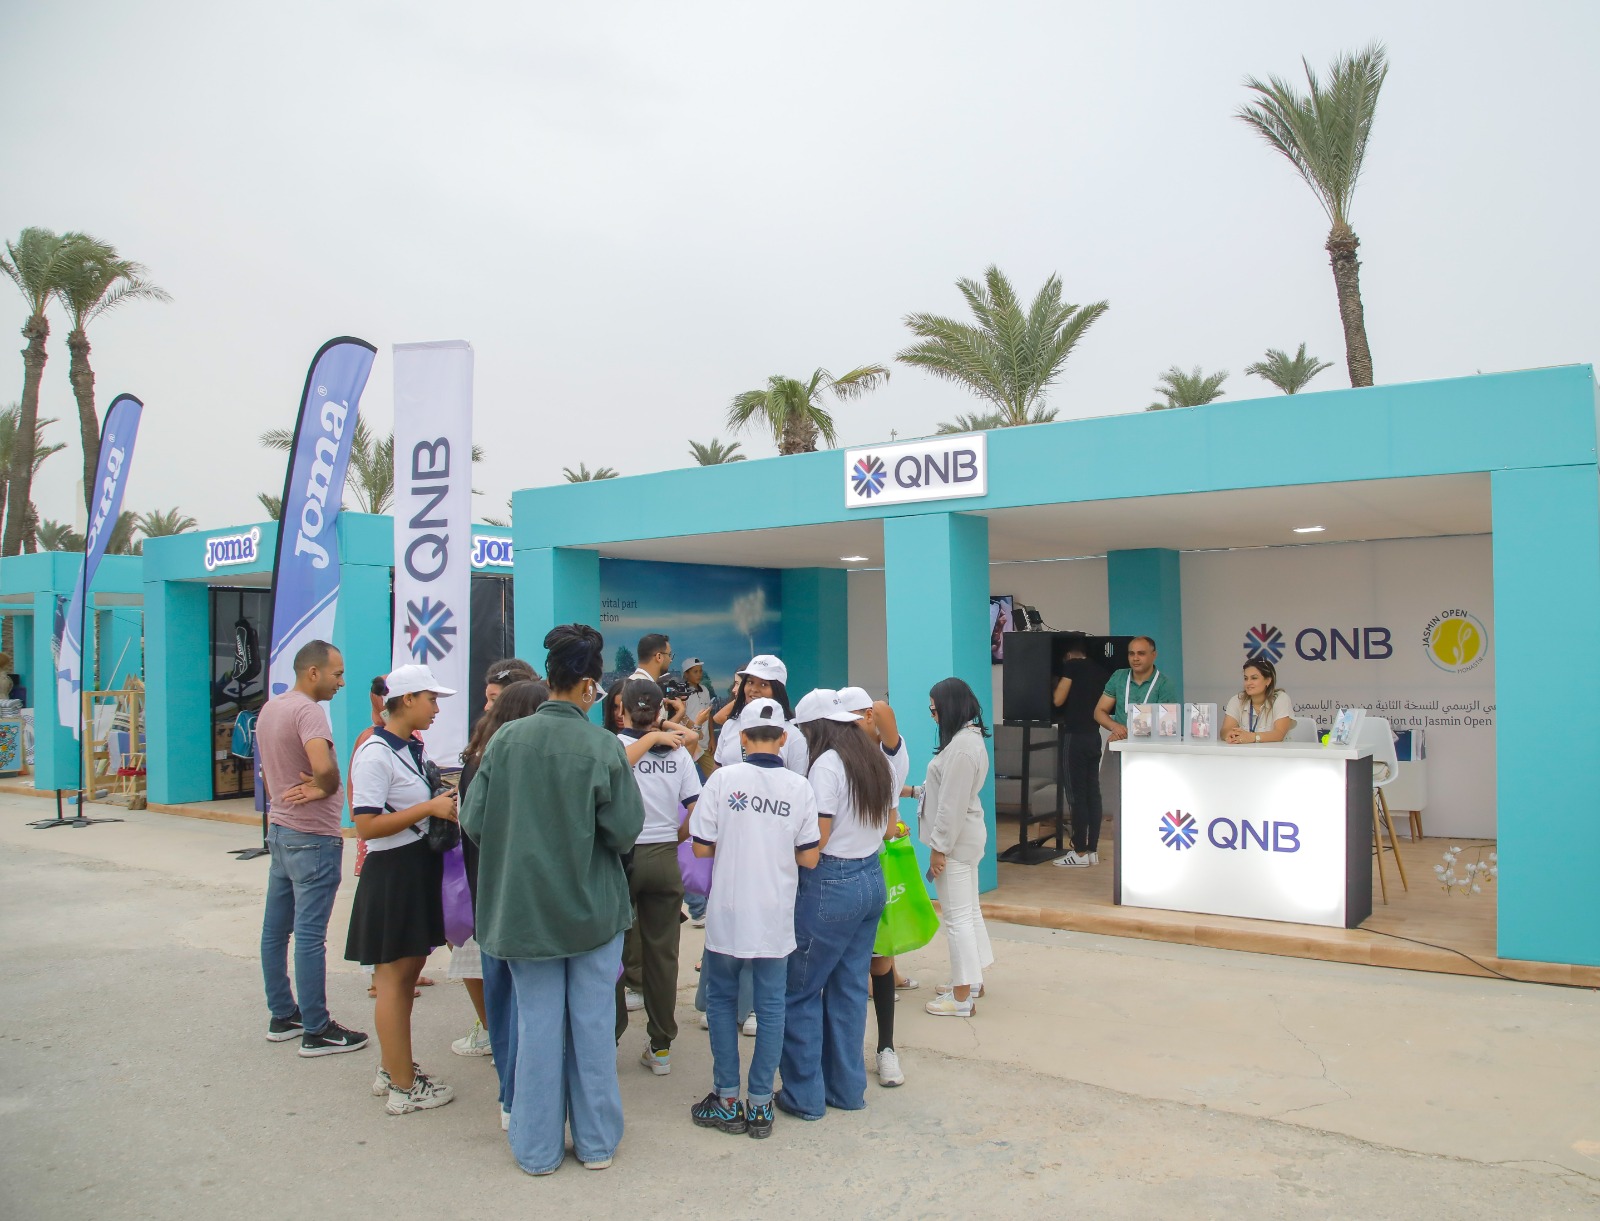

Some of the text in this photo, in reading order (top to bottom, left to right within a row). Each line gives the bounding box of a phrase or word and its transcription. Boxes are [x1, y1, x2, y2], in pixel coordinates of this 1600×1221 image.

[295, 400, 348, 569] Joma
[894, 449, 978, 489] QNB
[87, 446, 125, 558] oma
[404, 436, 450, 582] QNB
[207, 536, 254, 567] Joma
[600, 612, 619, 622] ction
[602, 598, 638, 610] vital part
[1295, 627, 1393, 661] QNB
[1422, 609, 1468, 648] JASMIN OPEN
[1293, 700, 1332, 712] الياسمين
[1409, 715, 1422, 726] du
[1424, 715, 1461, 727] Jasmin
[1463, 715, 1492, 729] Open
[638, 760, 677, 774] QNB
[751, 795, 791, 817] QNB
[1207, 817, 1301, 853] QNB
